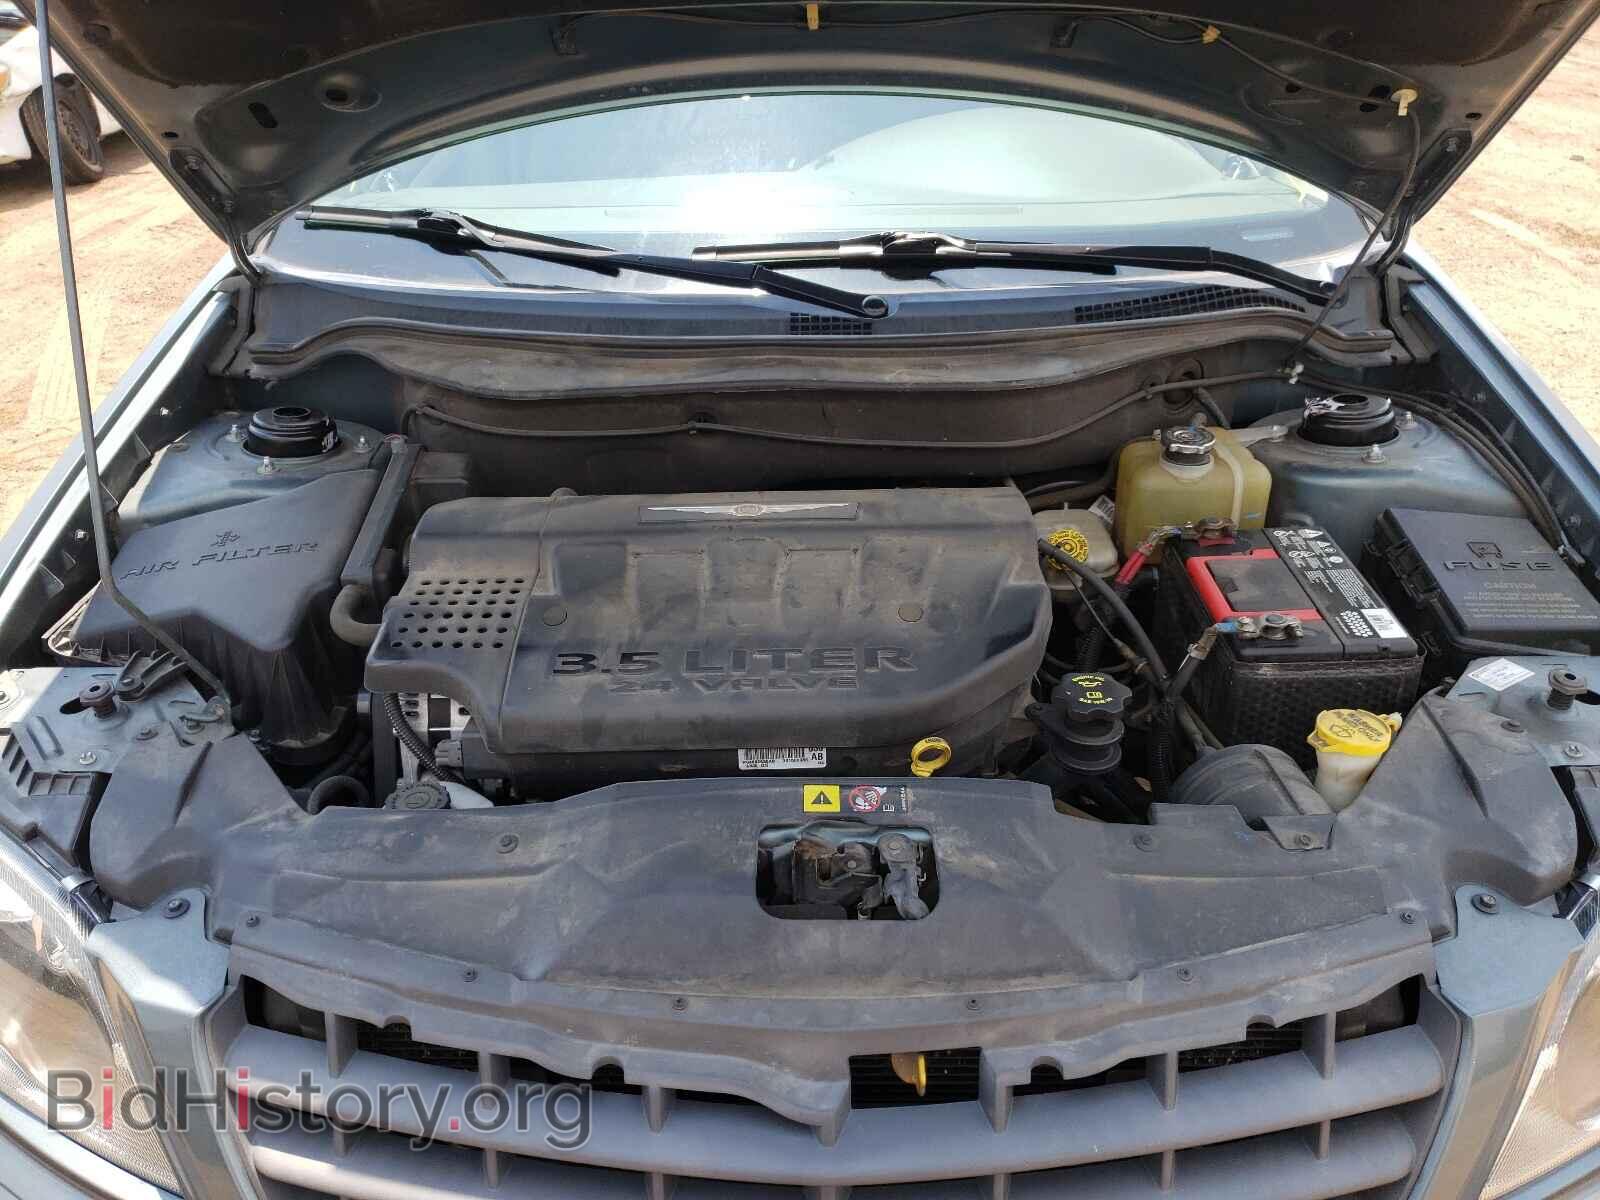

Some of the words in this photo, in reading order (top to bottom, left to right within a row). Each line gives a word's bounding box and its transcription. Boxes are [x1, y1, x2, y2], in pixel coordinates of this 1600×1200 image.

[120, 559, 179, 580] AIR
[192, 543, 318, 566] FILTER
[1443, 561, 1554, 571] FUSE
[552, 651, 660, 676] 3.5
[682, 648, 919, 676] LITER
[690, 676, 859, 693] VALVE
[811, 752, 824, 760] AB
